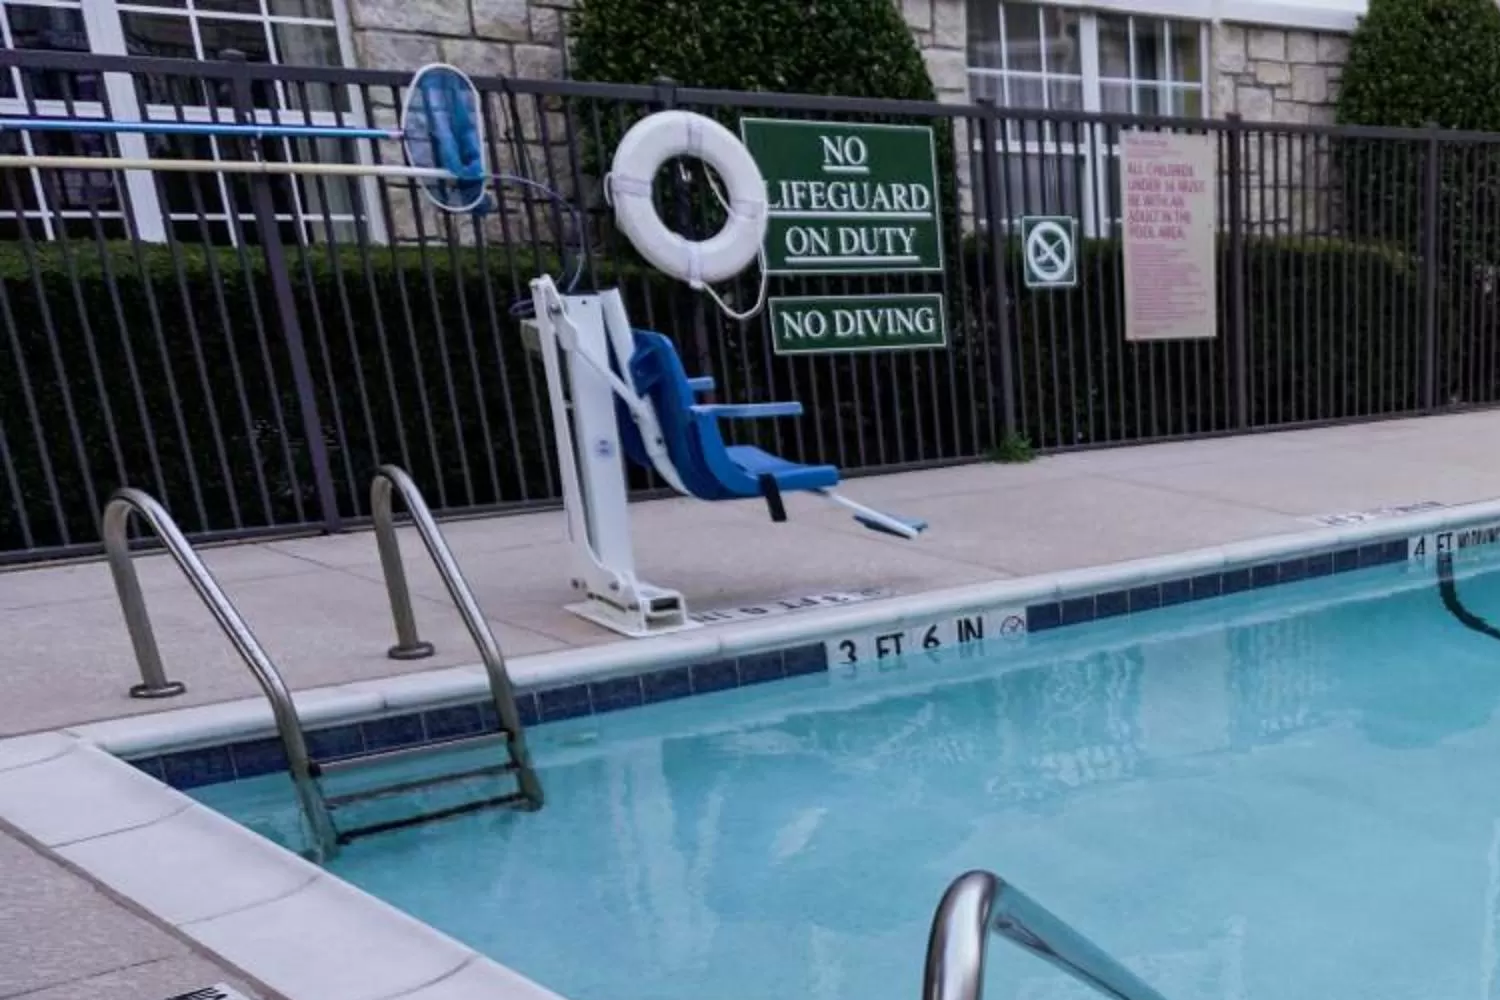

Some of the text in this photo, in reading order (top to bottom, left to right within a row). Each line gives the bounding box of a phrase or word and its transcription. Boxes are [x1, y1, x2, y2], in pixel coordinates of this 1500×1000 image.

[820, 135, 867, 165] NO
[785, 226, 917, 255] ON DUTY
[780, 307, 935, 340] NO DIVING
[1413, 537, 1426, 556] 4
[1437, 532, 1453, 550] FT
[839, 615, 984, 664] 3 FT 6 IN
